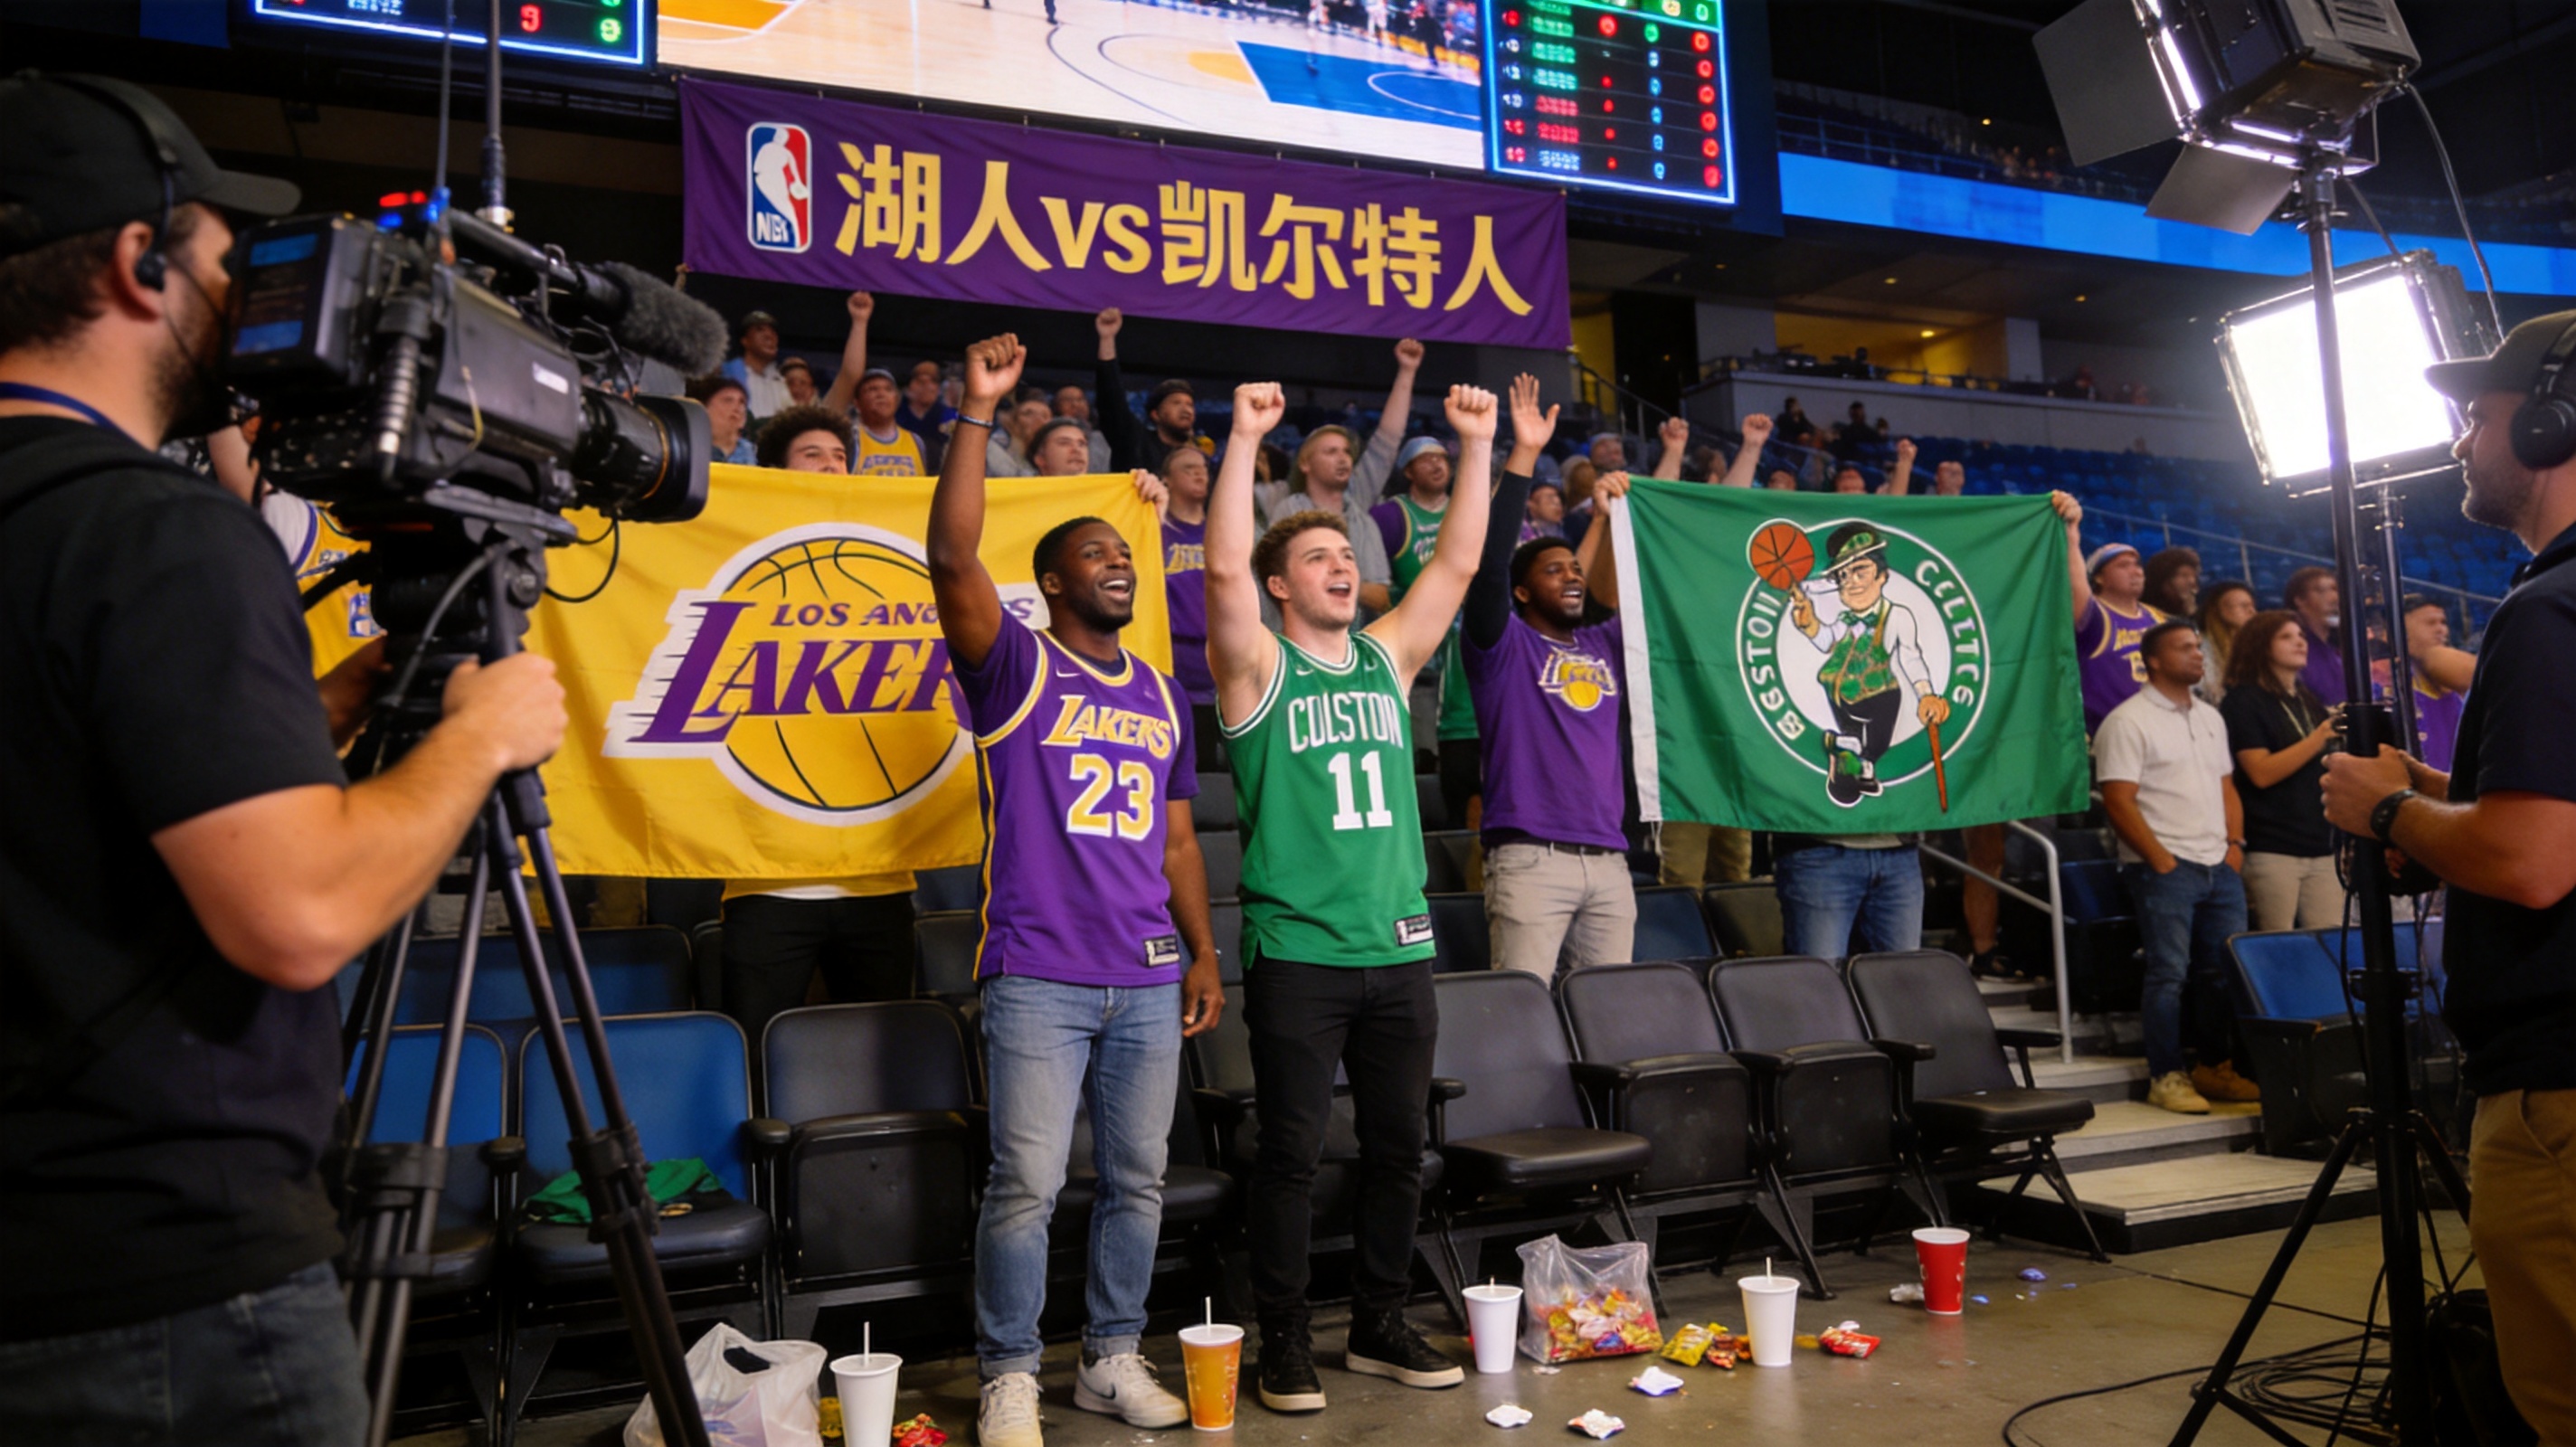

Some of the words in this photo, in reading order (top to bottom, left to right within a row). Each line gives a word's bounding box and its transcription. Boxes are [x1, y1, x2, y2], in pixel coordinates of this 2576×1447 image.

[771, 602, 850, 626] LOS
[627, 601, 973, 742] LAKER
[1040, 694, 1172, 760] LAKERS
[1065, 752, 1154, 842] 23
[1327, 751, 1393, 830] 11
